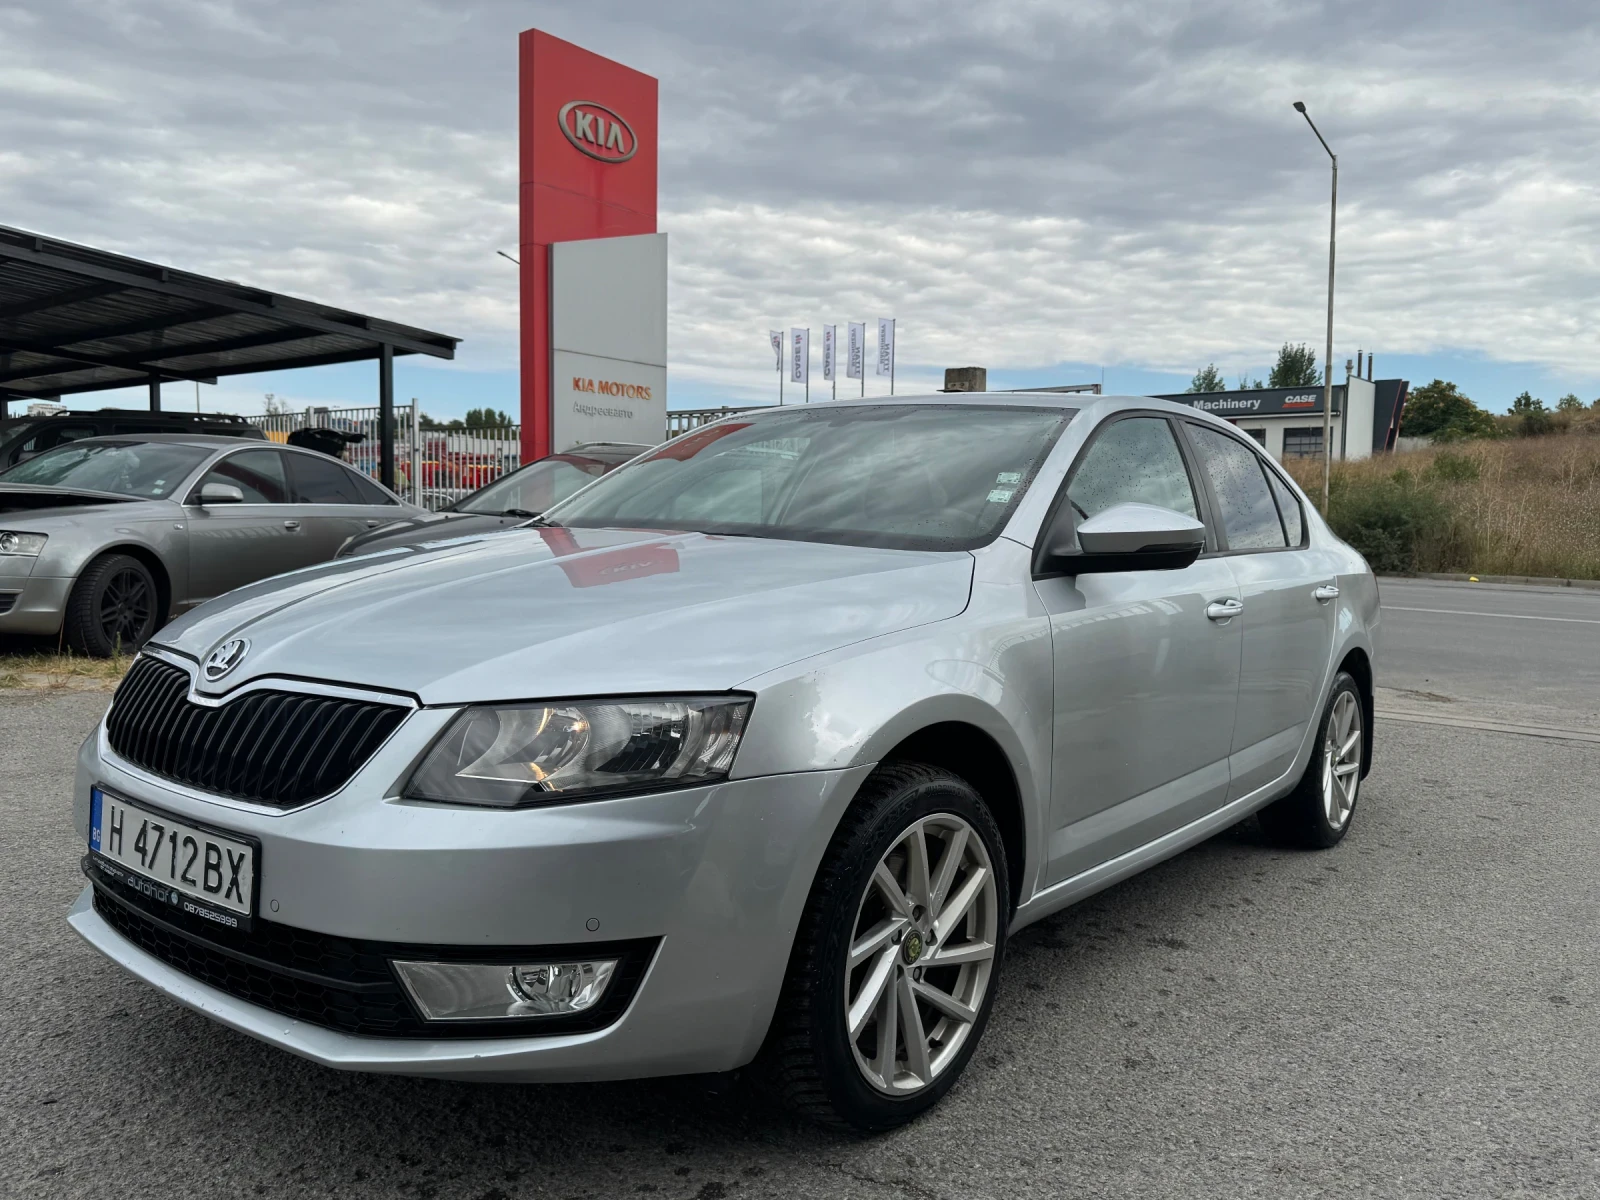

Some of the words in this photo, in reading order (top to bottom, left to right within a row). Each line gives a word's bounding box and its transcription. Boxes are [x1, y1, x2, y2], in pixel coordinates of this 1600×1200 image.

[575, 109, 625, 154] KIA
[573, 377, 595, 393] KIA
[598, 380, 652, 400] MOTORS
[1193, 399, 1261, 410] Machinery
[1285, 394, 1317, 403] CASE
[92, 826, 101, 842] BG
